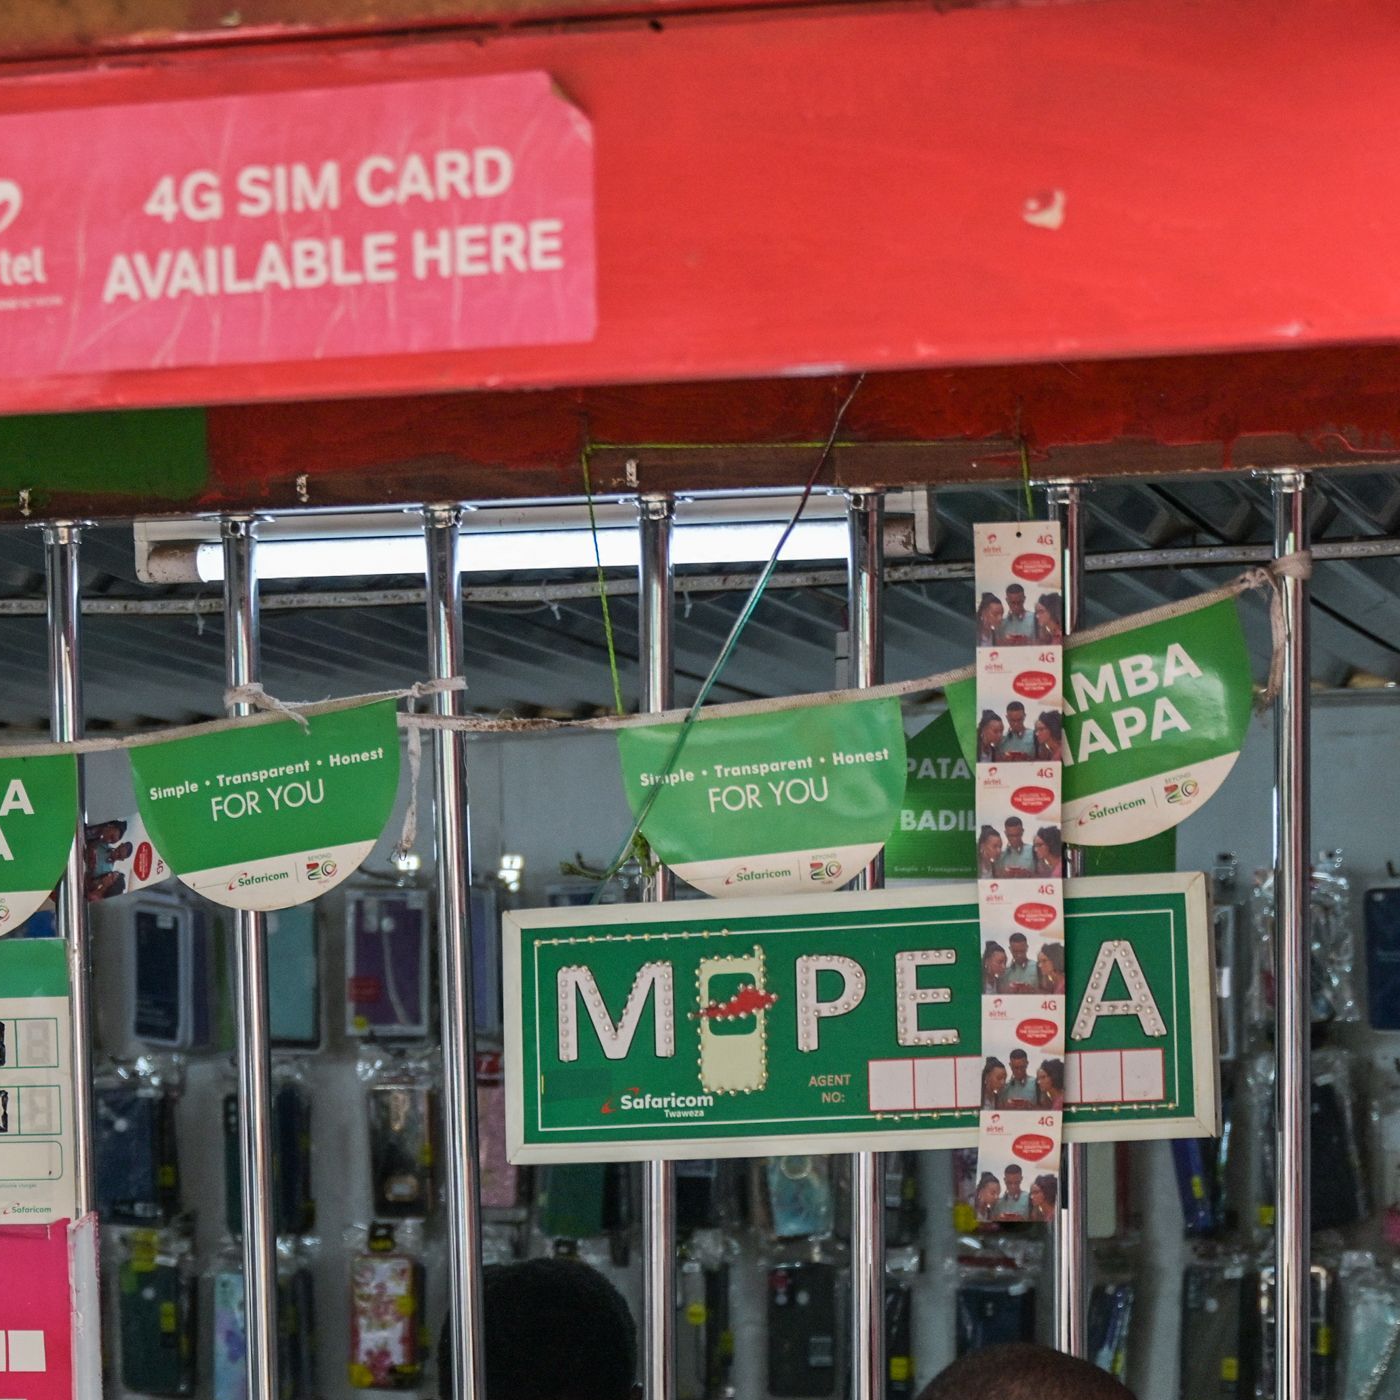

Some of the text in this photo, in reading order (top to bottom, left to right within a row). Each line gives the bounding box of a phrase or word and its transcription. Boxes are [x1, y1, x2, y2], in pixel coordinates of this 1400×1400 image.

[143, 146, 514, 223] 4G SIM CARD
[103, 219, 565, 303] AVAILABLE HERE
[1036, 534, 1054, 546] 4G
[1038, 652, 1055, 663] 4G
[150, 746, 385, 801] Simple Transparent Honest
[639, 747, 890, 788] Simple Transparent Honest
[906, 758, 971, 780] PATA
[1036, 768, 1054, 779] 4G
[211, 779, 326, 822] FOR YOU
[707, 776, 830, 815] FOR YOU
[1088, 797, 1147, 820] Safaricom
[238, 870, 289, 888] Safaricom
[736, 869, 792, 882] Safaricom
[1038, 884, 1055, 895] 4G
[1040, 1000, 1057, 1012] 4G
[808, 1073, 852, 1088] AGENT
[619, 1091, 714, 1111] Safaricom
[822, 1091, 846, 1104] NO:
[663, 1109, 707, 1119] Twaweza
[1037, 1115, 1054, 1127] 4G
